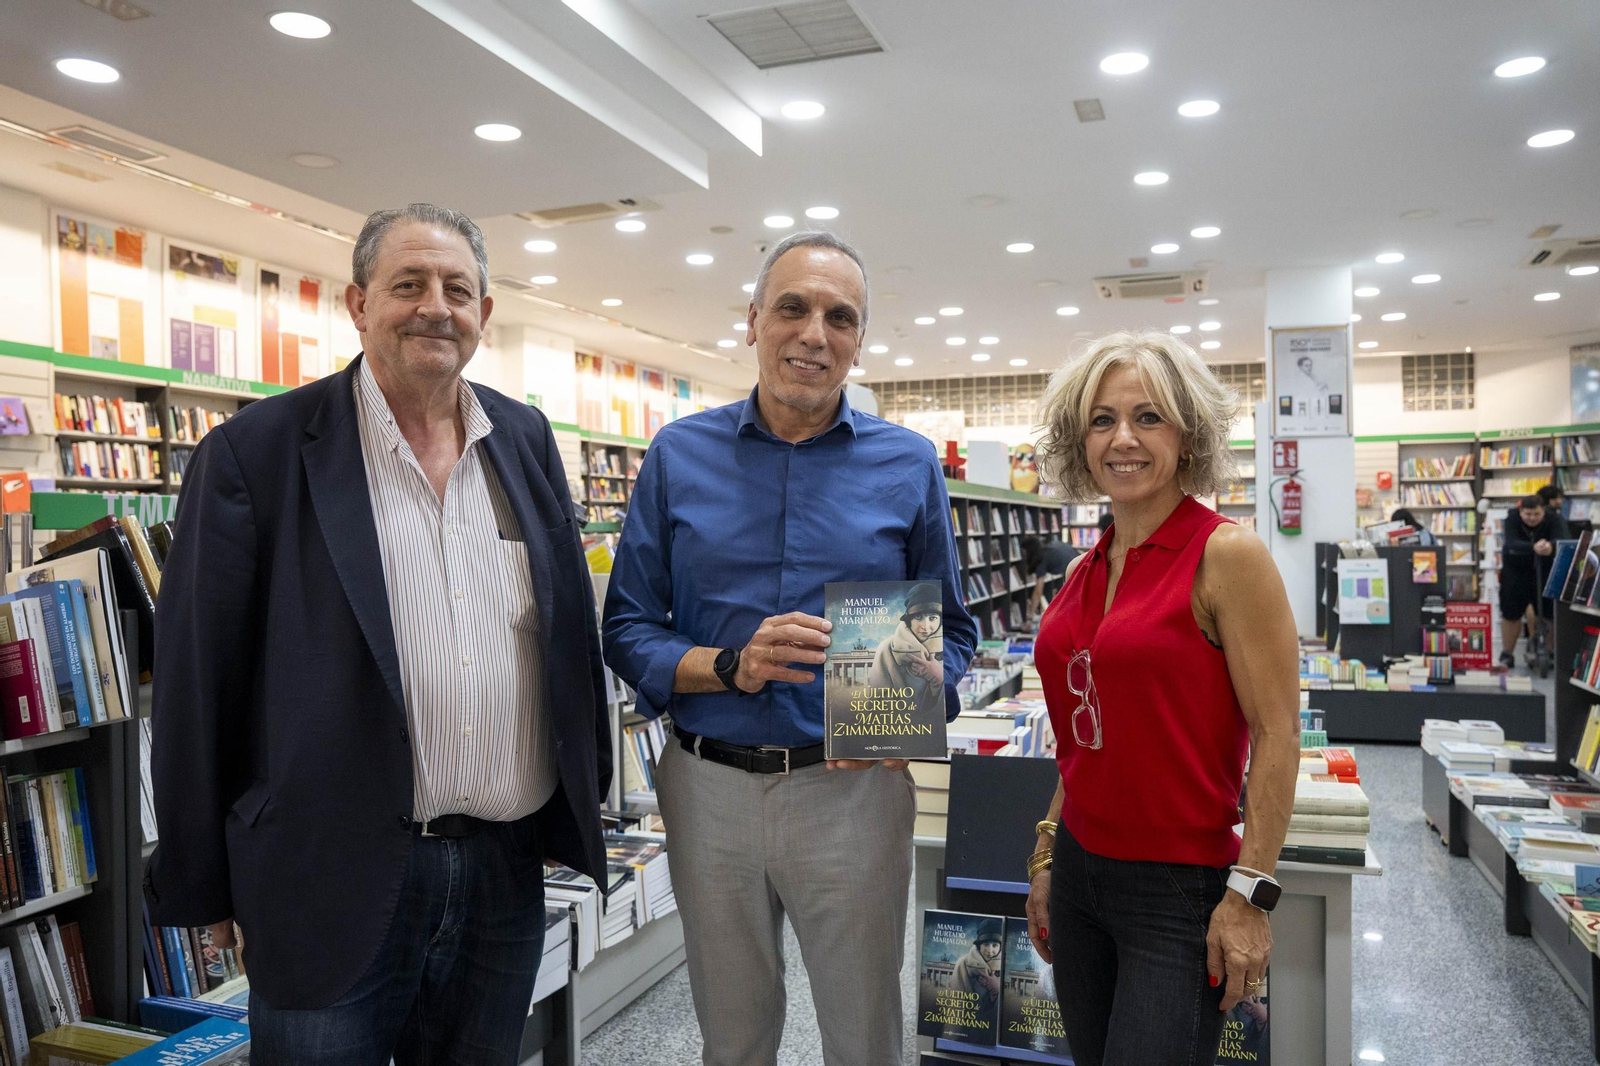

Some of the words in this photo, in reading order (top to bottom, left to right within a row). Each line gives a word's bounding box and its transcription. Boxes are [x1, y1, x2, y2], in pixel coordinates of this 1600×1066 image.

[183, 371, 251, 392] NARRATIVA
[845, 598, 885, 606] MANUEL
[59, 602, 68, 625] ALMERÍA
[842, 607, 888, 615] HURTADO
[839, 616, 890, 626] MARJALIZO
[65, 633, 75, 663] DOMINICOS
[863, 686, 914, 698] ÚLTIMO
[850, 700, 906, 712] SECRETO
[908, 703, 917, 711] de
[855, 711, 911, 726] MATÍAS
[834, 723, 932, 737] ZIMMERMANN
[937, 923, 963, 932] MANUEL
[934, 930, 966, 938] HURTADO
[932, 936, 967, 945] MARJALIZO
[944, 988, 980, 1000] ÚLTIMO
[936, 998, 974, 1010] SECRETO
[1030, 997, 1059, 1009] ÚLTIM
[938, 1006, 976, 1019] MATÍAS
[1021, 1007, 1060, 1019] SECRETO
[924, 1012, 990, 1029] ZIMMERMANN
[1023, 1016, 1063, 1029] MATÍAS
[1008, 1021, 1066, 1038] ZIMMERMAN
[1220, 1038, 1241, 1050] TÍAS
[1218, 1048, 1257, 1061] RMANN
